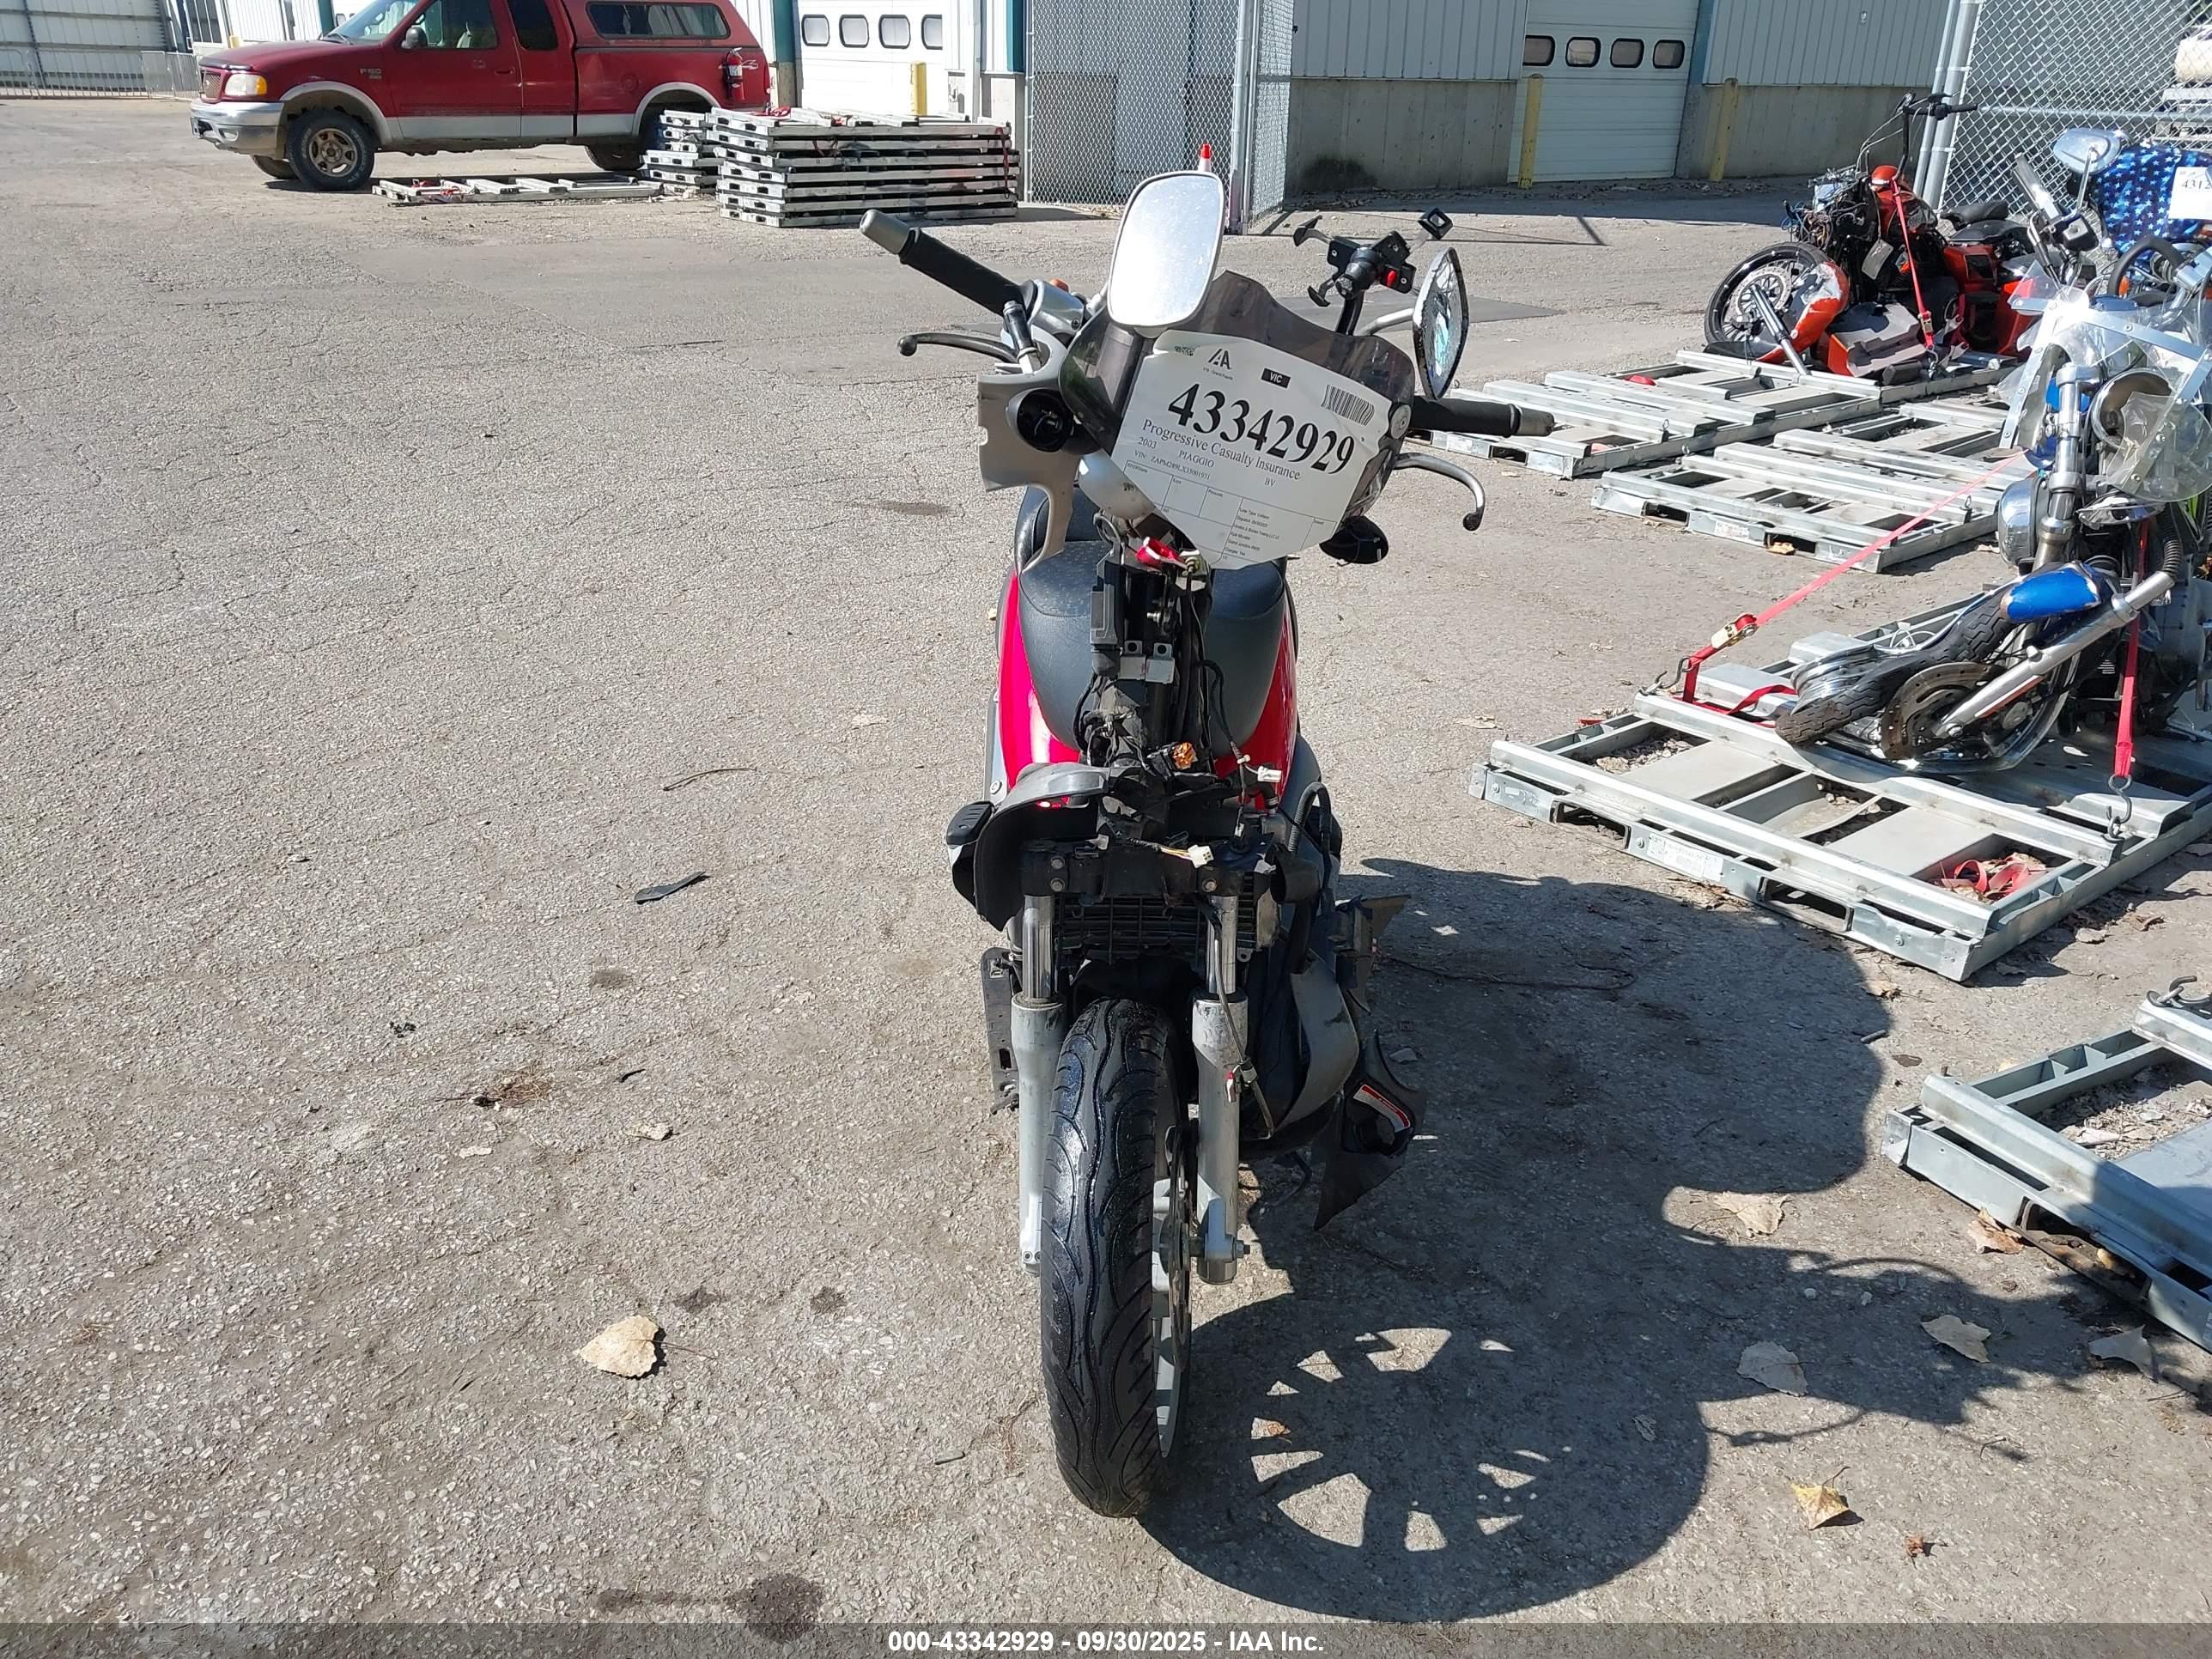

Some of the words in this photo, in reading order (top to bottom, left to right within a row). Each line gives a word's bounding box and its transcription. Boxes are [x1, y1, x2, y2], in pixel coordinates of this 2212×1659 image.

[1269, 371, 1283, 384] VIC
[1168, 383, 1355, 475] 43342929
[1134, 449, 1148, 461] VIN:
[1138, 436, 1158, 449] 2003
[1179, 449, 1215, 468] PIAGGIO
[1142, 418, 1208, 451] Progressive
[1211, 442, 1254, 468] Casualty
[1255, 456, 1301, 480] Insurance
